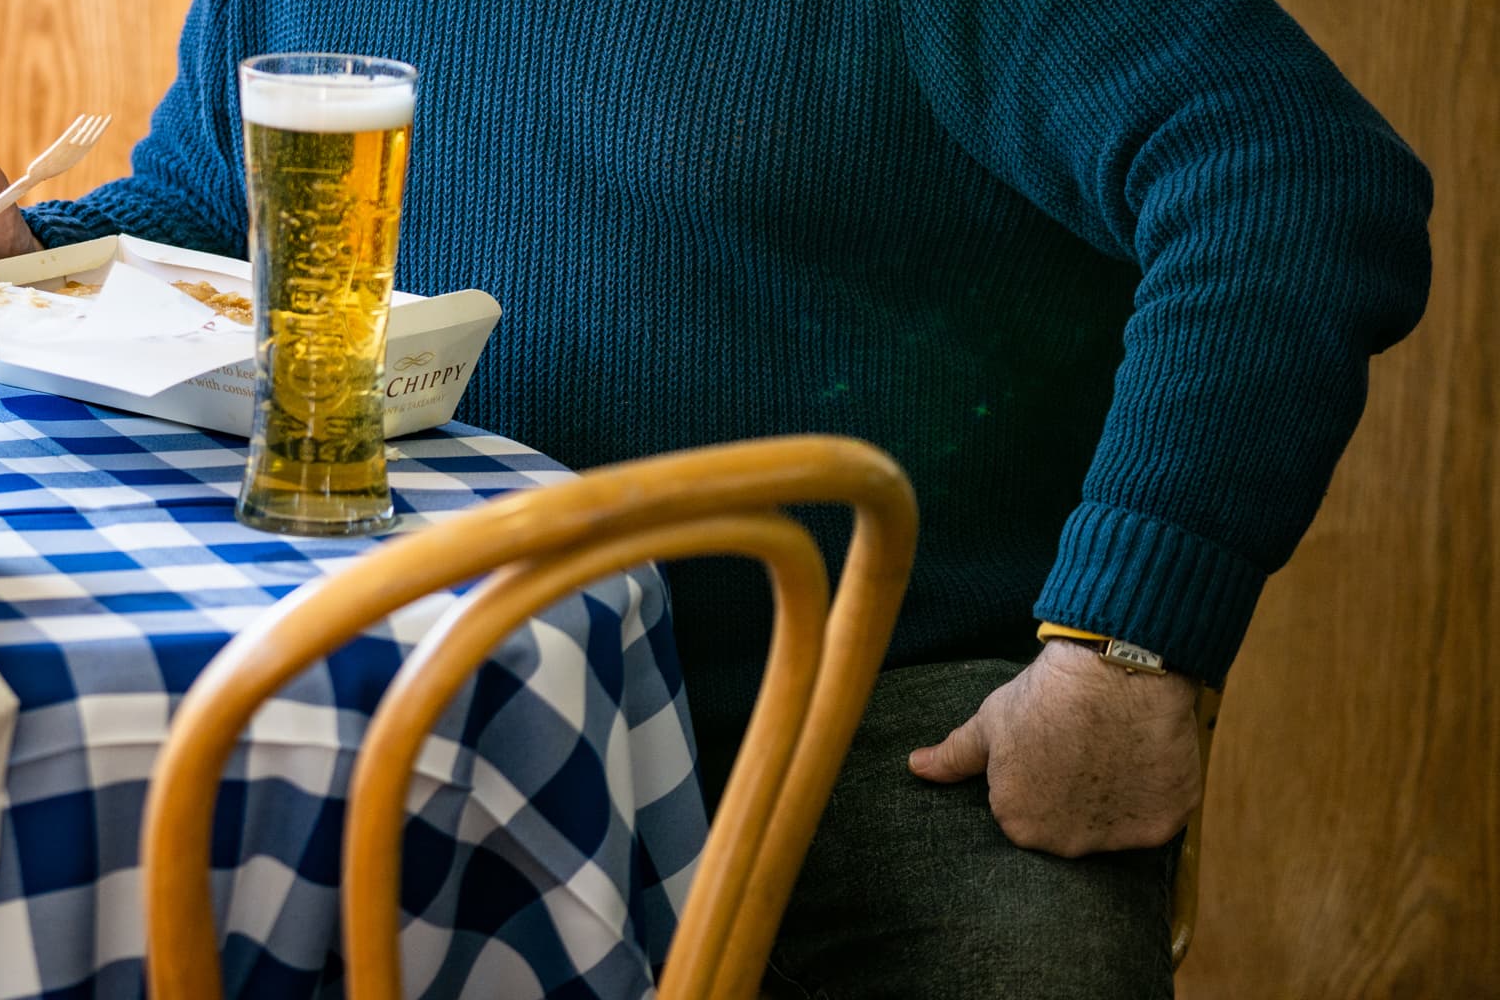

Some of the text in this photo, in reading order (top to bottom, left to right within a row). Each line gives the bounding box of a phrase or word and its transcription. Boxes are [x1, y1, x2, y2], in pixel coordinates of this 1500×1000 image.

[222, 366, 233, 376] to
[236, 366, 255, 380] kee
[386, 362, 466, 398] CHIPPY
[195, 378, 220, 391] with
